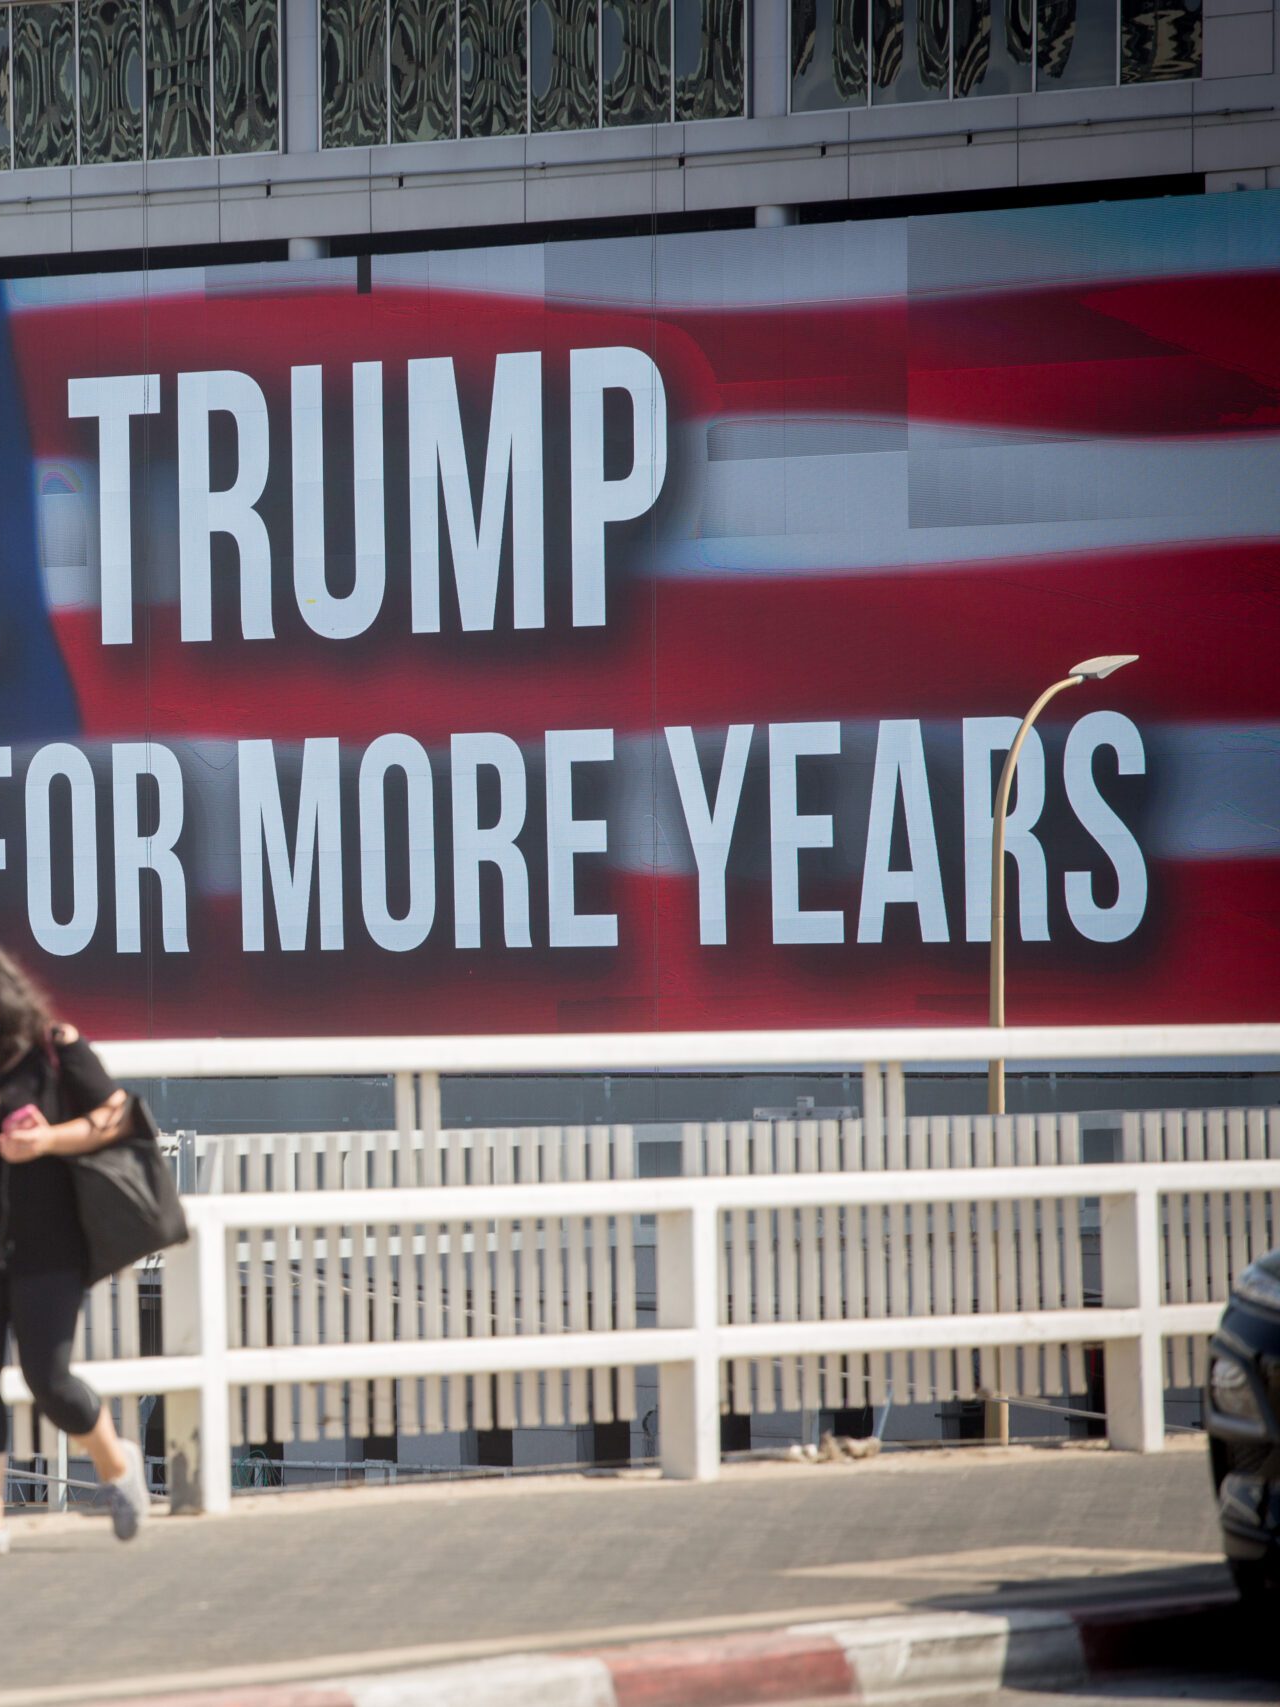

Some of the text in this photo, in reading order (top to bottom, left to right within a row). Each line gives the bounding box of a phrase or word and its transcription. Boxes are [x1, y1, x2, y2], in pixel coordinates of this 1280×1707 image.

[67, 346, 668, 645] TRUMP
[237, 729, 619, 953] MORE
[663, 710, 1148, 946] YEARS
